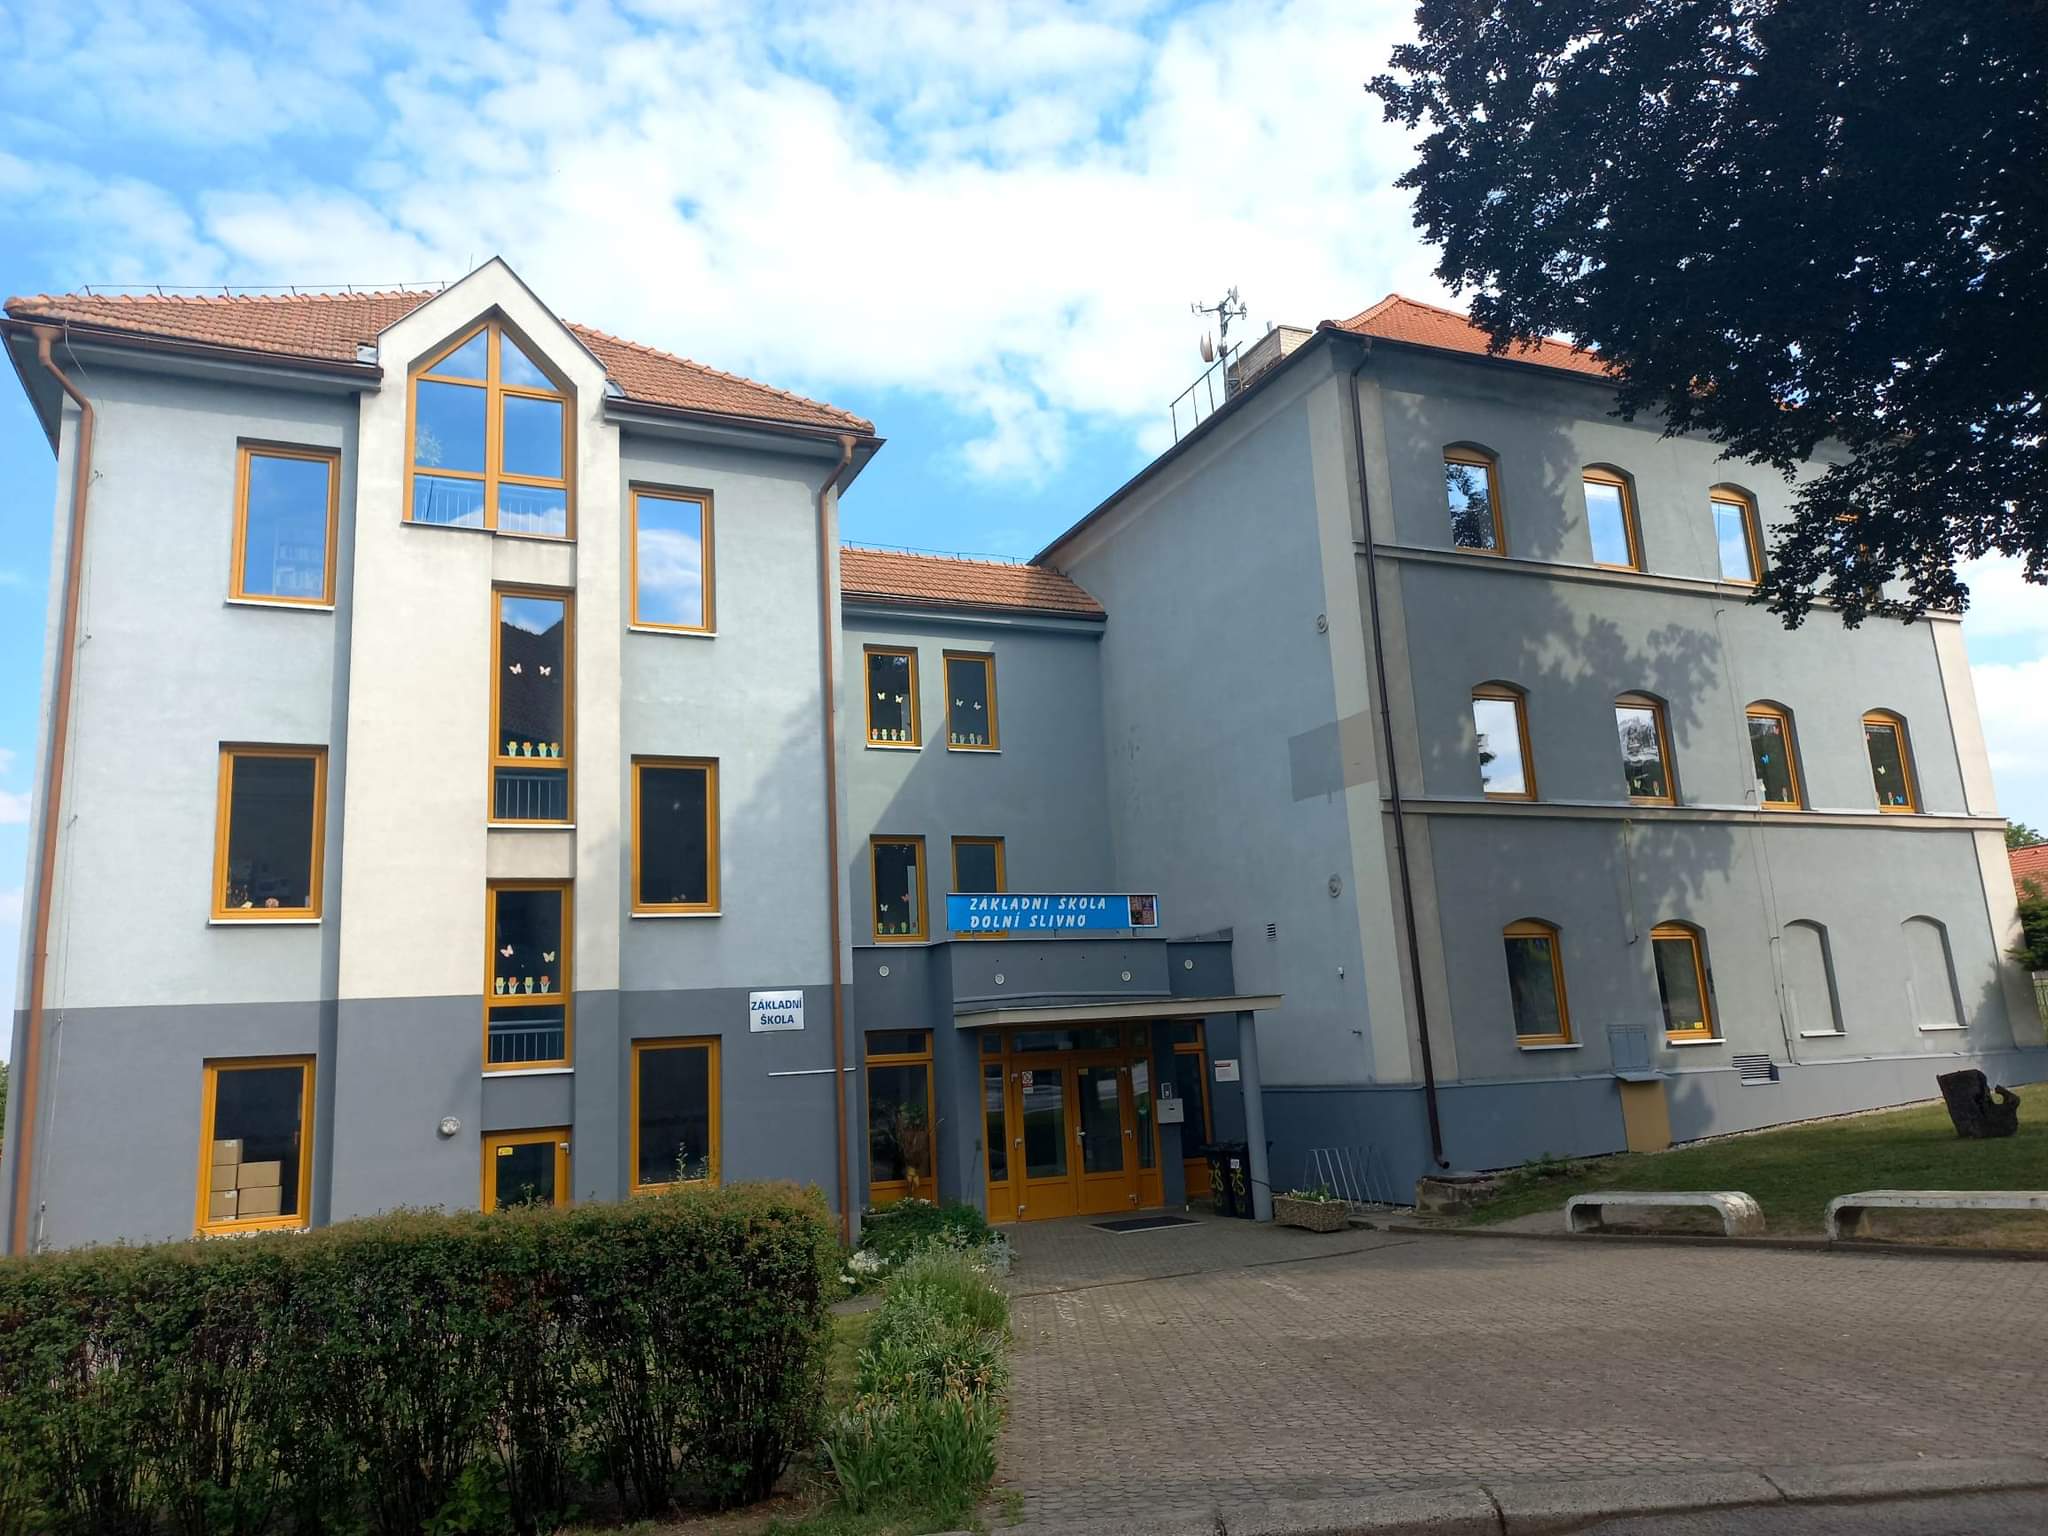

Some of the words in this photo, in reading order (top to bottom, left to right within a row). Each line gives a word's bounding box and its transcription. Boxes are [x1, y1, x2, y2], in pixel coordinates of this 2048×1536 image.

[970, 912, 1021, 928] DOLNÍ
[1029, 914, 1086, 928] SLIVNO
[751, 998, 802, 1011] ZÁKLADNÍ
[760, 1013, 795, 1025] ŠKOLA
